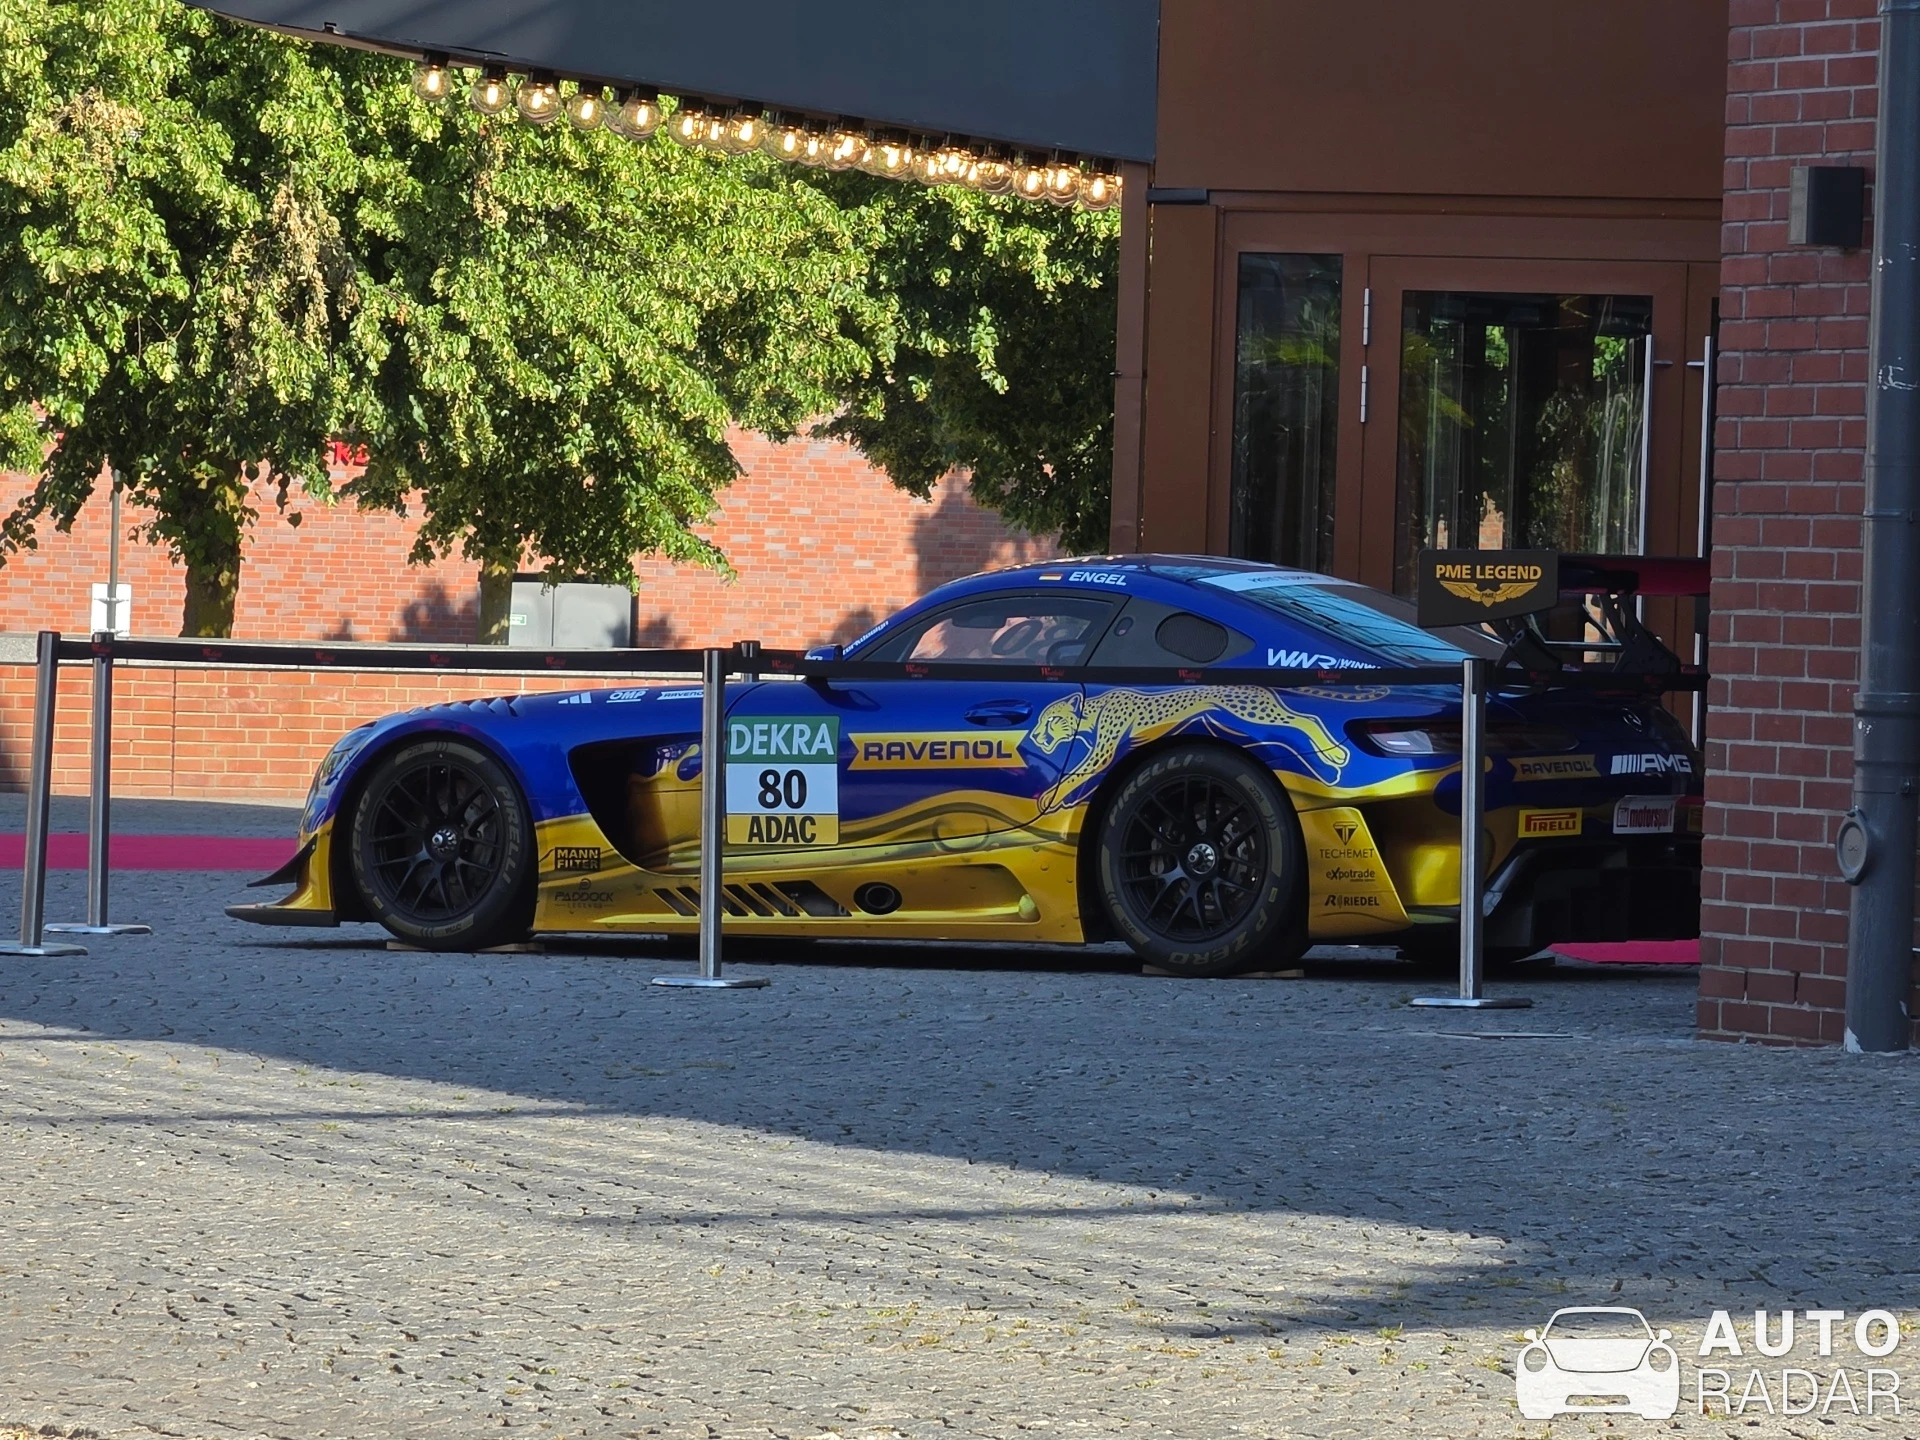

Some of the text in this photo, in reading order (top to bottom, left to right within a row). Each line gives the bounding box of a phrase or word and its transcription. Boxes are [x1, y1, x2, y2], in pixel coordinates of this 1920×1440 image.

[1068, 571, 1127, 586] ENGEL
[1436, 564, 1542, 580] PME LEGEND
[609, 690, 647, 700] OMP
[664, 691, 704, 699] RAVENO
[730, 723, 835, 755] DEKRA
[863, 740, 1012, 761] RAVENOL
[1520, 760, 1592, 775] RAVENOL
[758, 769, 807, 809] 80
[1108, 754, 1194, 827] PIRELLI
[747, 815, 816, 843] ADAC
[1525, 812, 1577, 832] PIRELLI
[497, 785, 520, 884] PIRELLI
[557, 849, 598, 859] MANN
[1319, 848, 1375, 859] TECHEMET
[557, 859, 598, 869] FILTER
[555, 891, 614, 902] PADDOCK
[1343, 896, 1380, 906] RIEDEL
